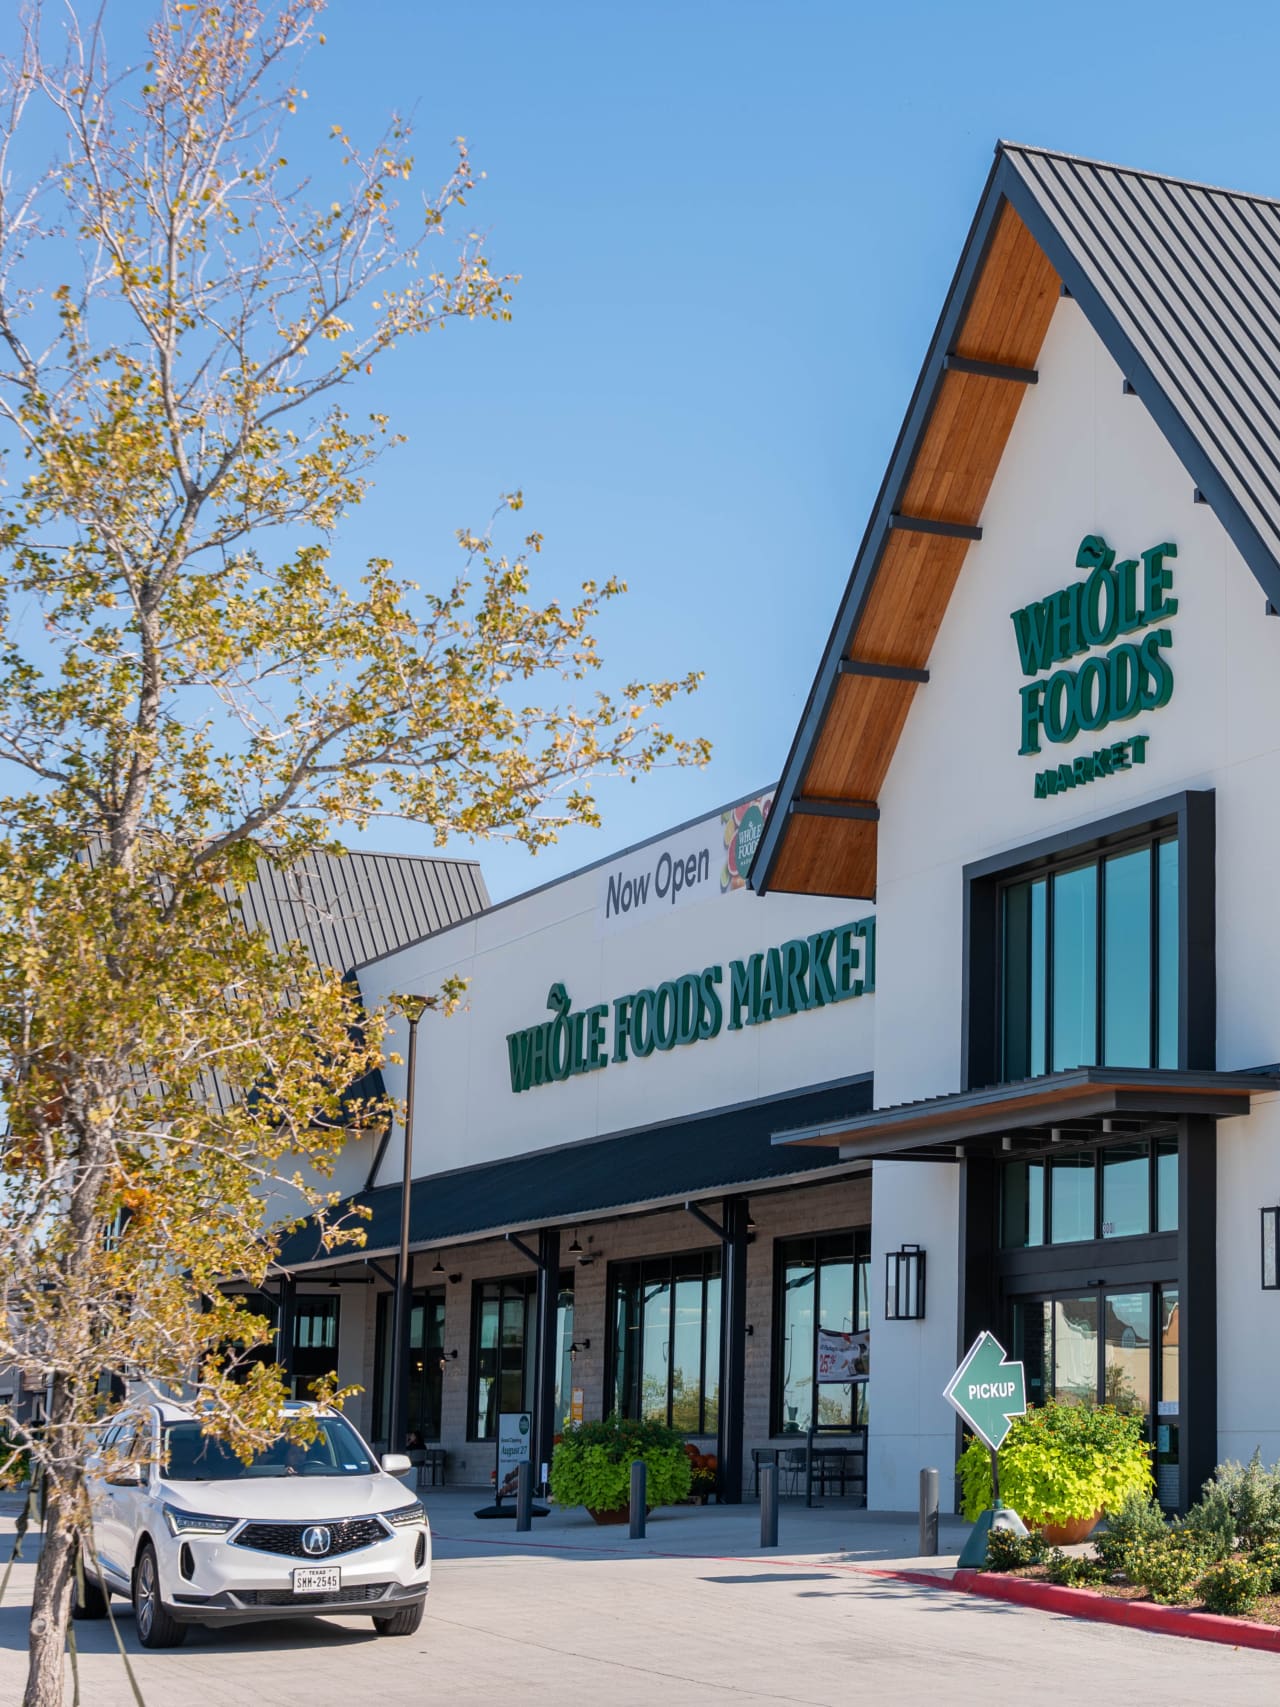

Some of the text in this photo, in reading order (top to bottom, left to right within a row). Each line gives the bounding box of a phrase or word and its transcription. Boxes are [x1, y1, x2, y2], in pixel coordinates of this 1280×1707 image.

[1010, 535, 1178, 676] WHOLE
[1018, 629, 1174, 756] FOODS
[1034, 735, 1149, 799] MARKET
[606, 848, 710, 919] Now Open
[506, 915, 876, 1093] WHOLE FOODS MARKET
[968, 1381, 1016, 1400] PICKUP
